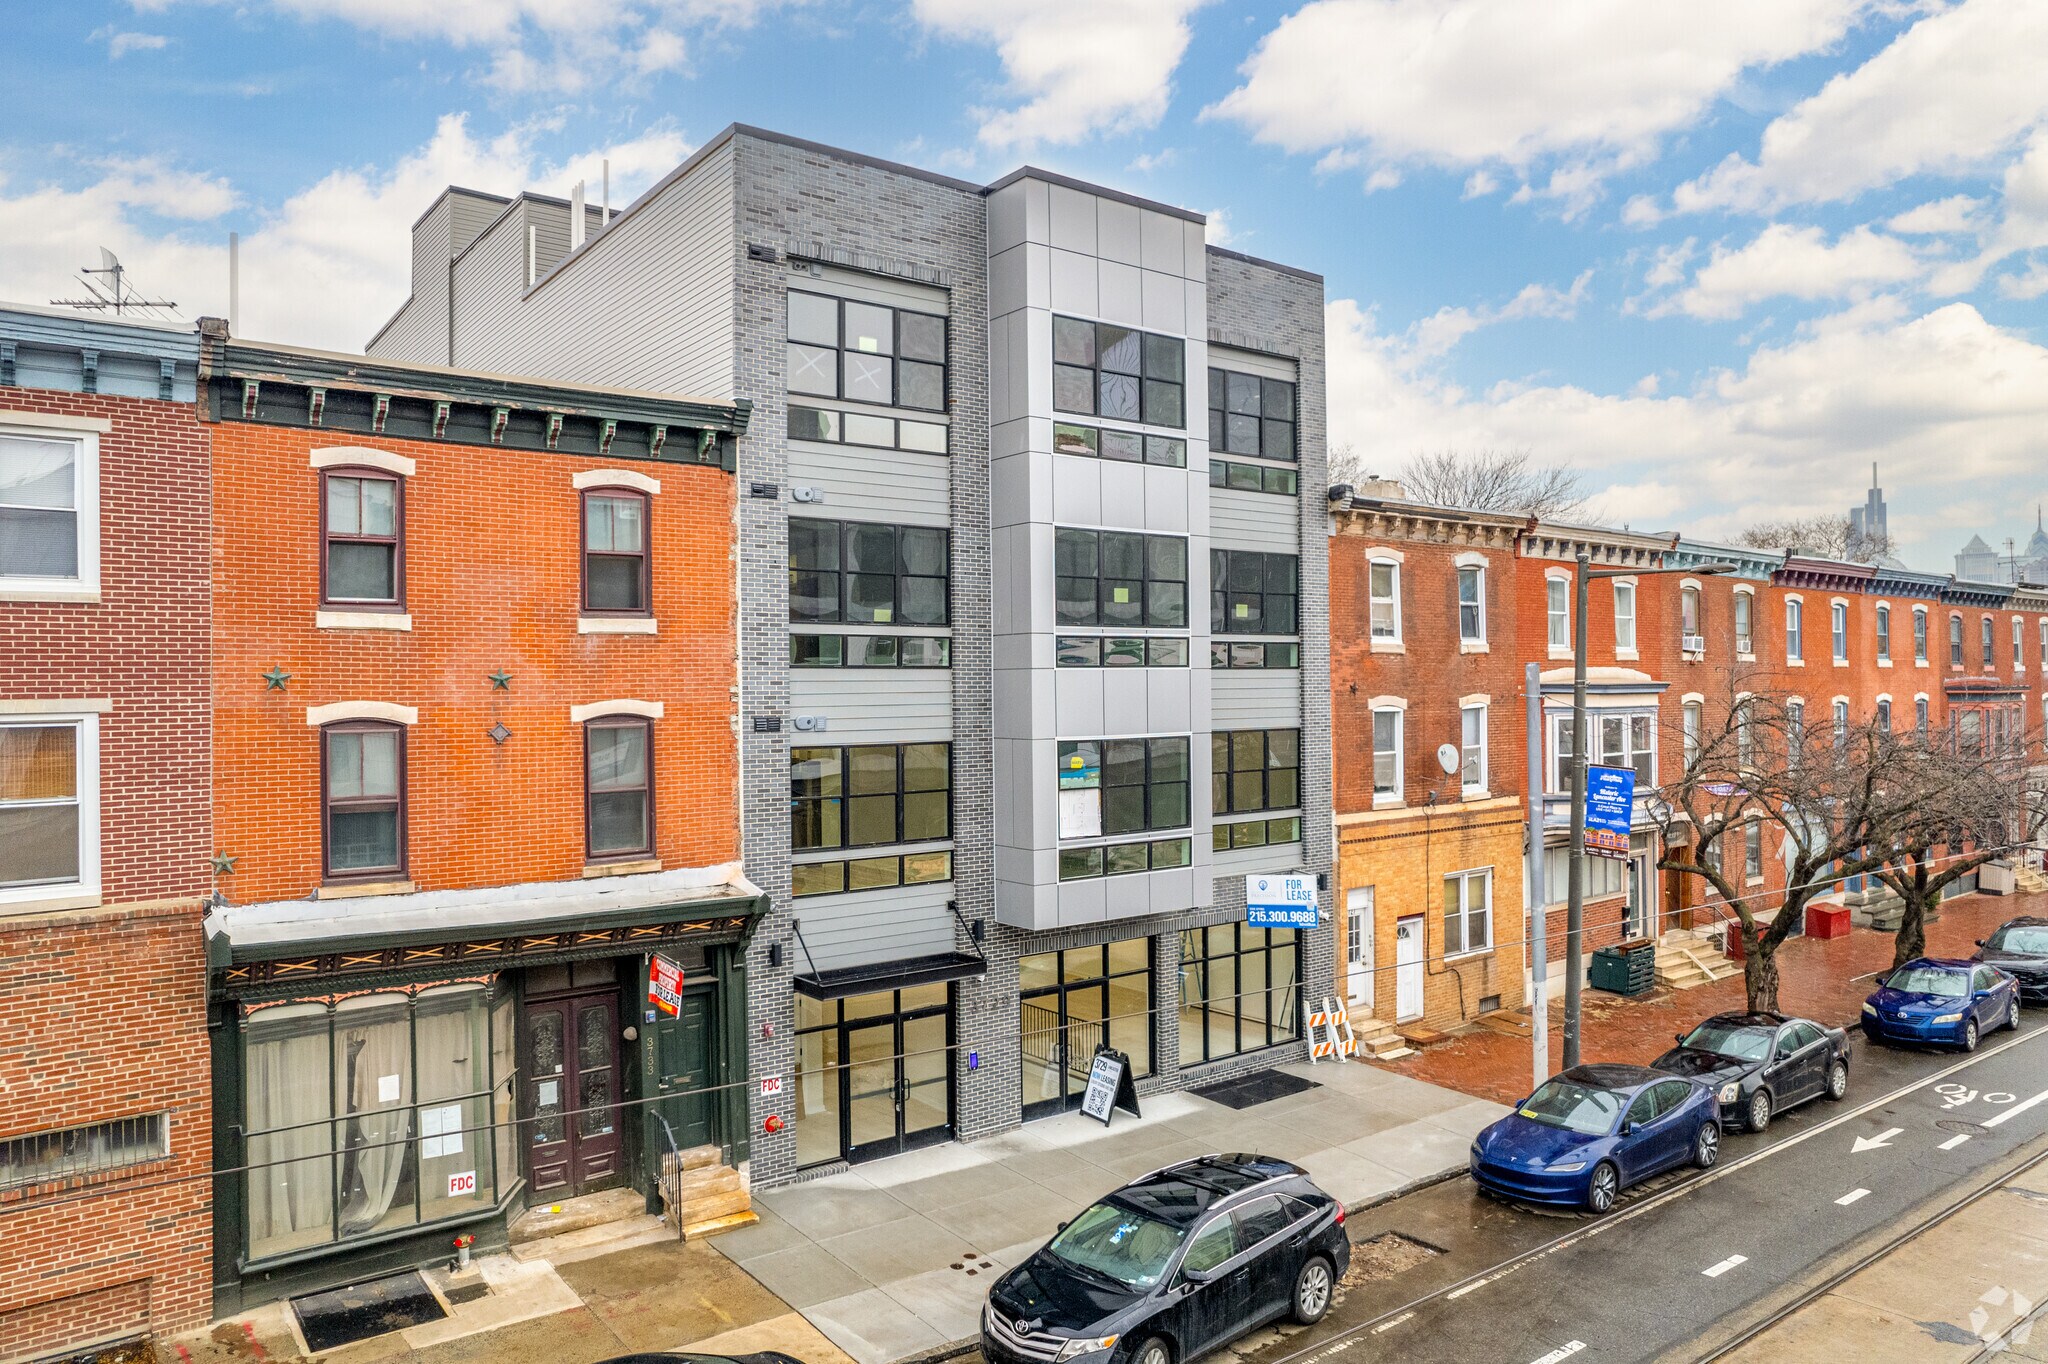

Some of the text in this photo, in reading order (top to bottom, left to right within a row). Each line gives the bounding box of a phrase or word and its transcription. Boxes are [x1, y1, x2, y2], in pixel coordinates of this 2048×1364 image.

[1286, 879, 1302, 889] FOR
[1287, 891, 1312, 900] LEASE
[1249, 911, 1316, 922] 215.300.9688
[646, 1037, 654, 1075] 3733
[1095, 1058, 1108, 1072] 3729
[762, 1077, 780, 1092] FDC
[1101, 1074, 1116, 1087] LEASING
[451, 1175, 473, 1192] FDC
